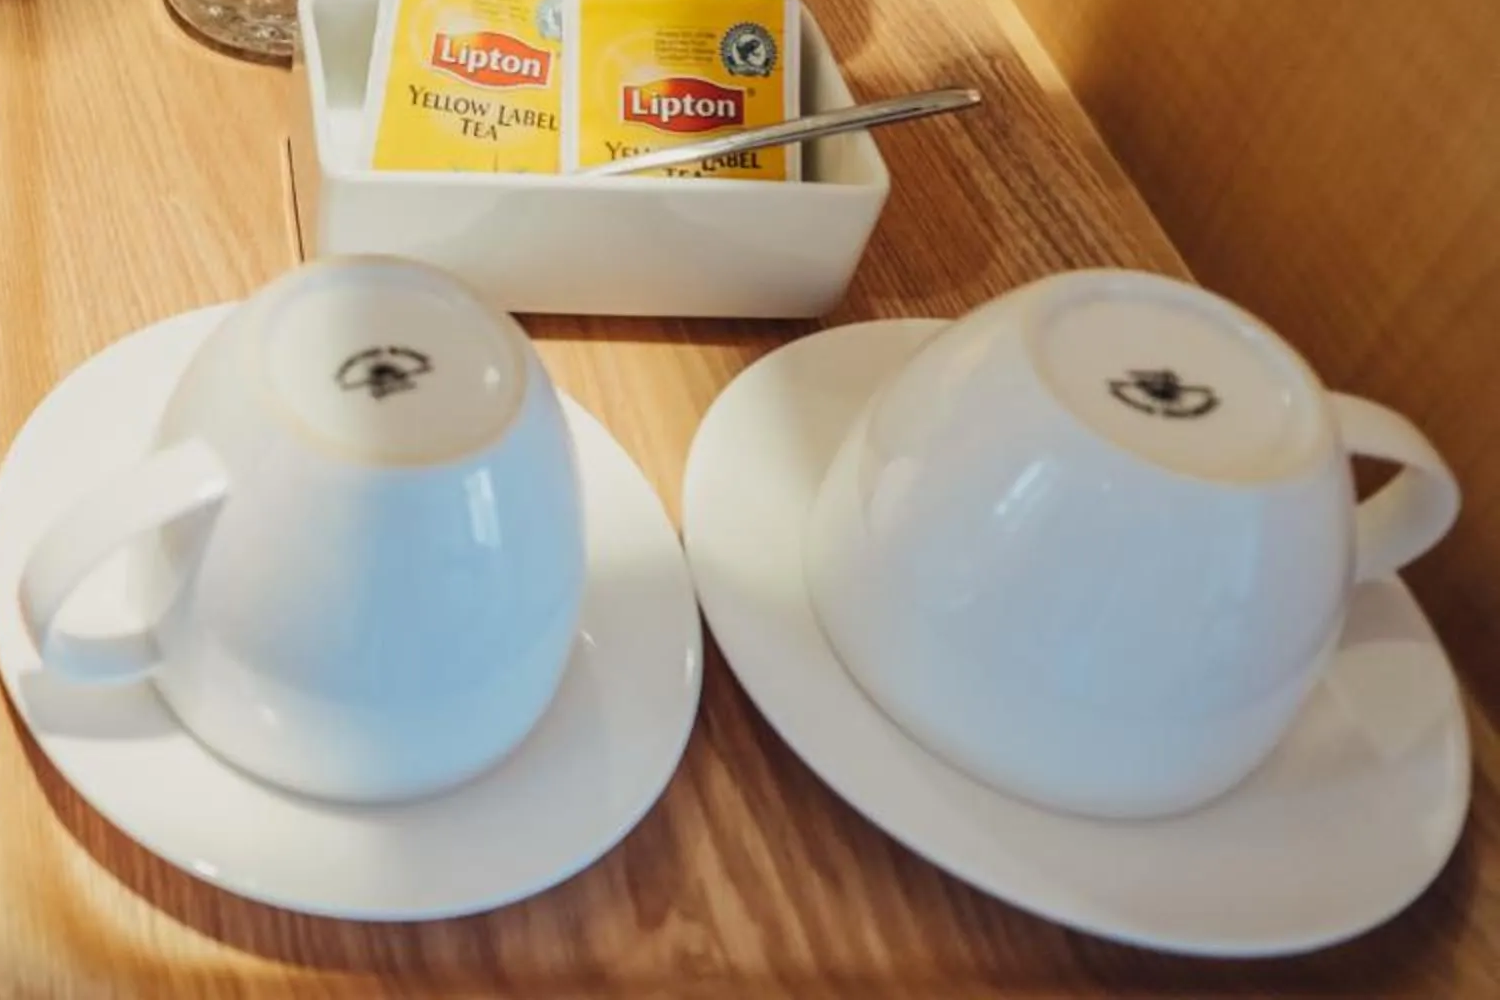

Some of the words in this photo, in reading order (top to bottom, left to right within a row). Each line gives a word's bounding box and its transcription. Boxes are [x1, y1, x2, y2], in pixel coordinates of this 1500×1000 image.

[439, 37, 543, 79] Lipton
[408, 85, 491, 118] YELLOW
[498, 103, 559, 132] LABEL
[631, 83, 737, 121] Lipton
[460, 118, 499, 142] TEA
